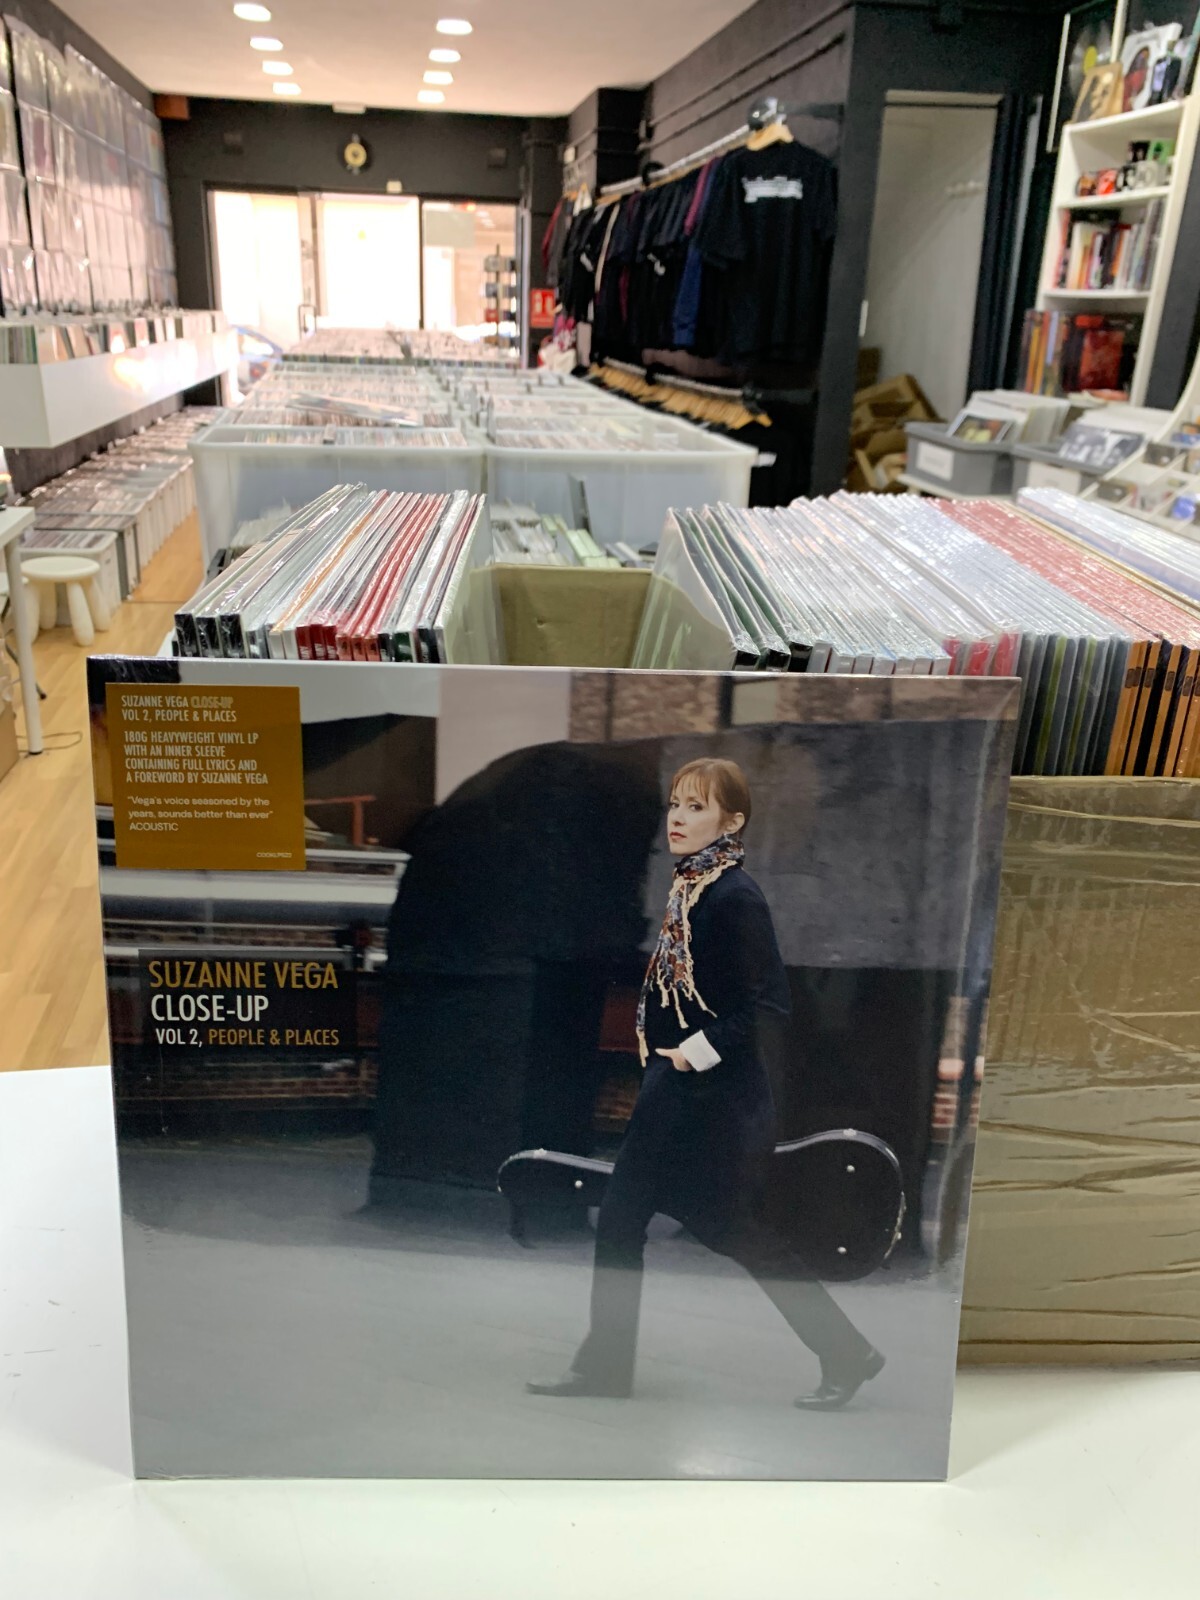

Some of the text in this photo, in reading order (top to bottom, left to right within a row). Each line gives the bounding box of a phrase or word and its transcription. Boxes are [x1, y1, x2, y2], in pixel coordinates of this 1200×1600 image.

[121, 695, 233, 709] SUZANNE VEGA CLOSE-UP
[122, 709, 237, 723] VOL 2, PEOPLE & PLACES
[124, 730, 259, 745] 180G HEAVYWEIGHT VINYL LP
[124, 745, 226, 757] WITH AN INNER SLEEVE
[125, 758, 258, 771] CONTAINING FULL LYRICS AND
[126, 771, 269, 784] A FOREWORD BY SUZANNE VEGA
[164, 797, 190, 806] voice
[192, 797, 238, 806] seasoned
[240, 797, 251, 808] by
[254, 797, 271, 806] the
[128, 810, 156, 820] years,
[158, 810, 193, 818] sounds
[194, 810, 223, 818] better
[225, 810, 248, 819] than
[129, 822, 179, 832] ACOUSTIC
[149, 960, 339, 989] SUZANNE VEGA
[151, 993, 269, 1022] CLOSE-UP
[155, 1028, 339, 1048] VOL 2, PEOPLE & PLACES
